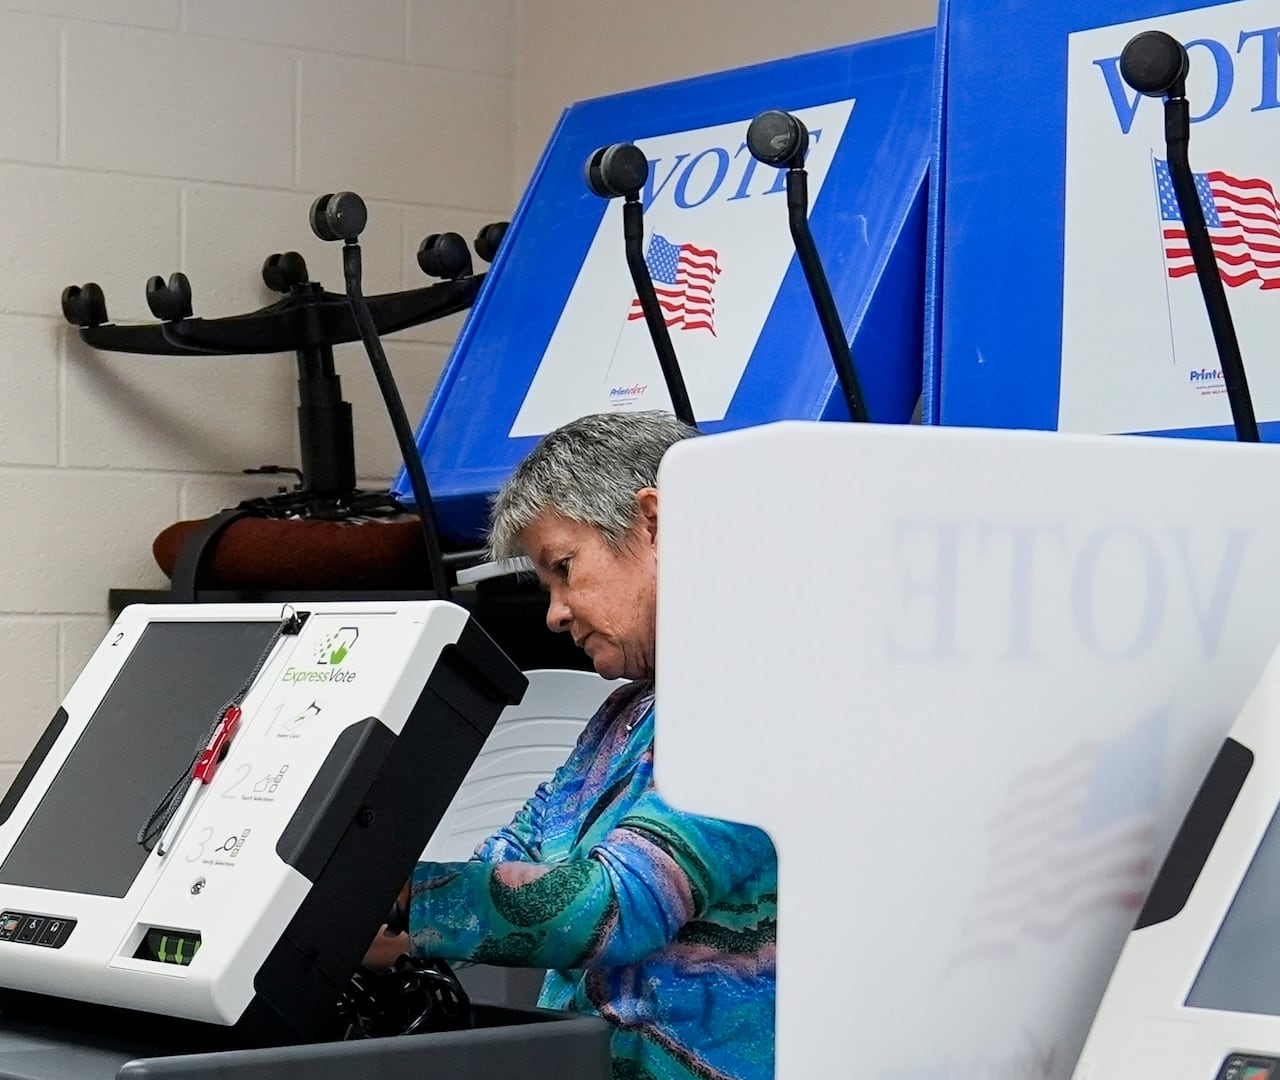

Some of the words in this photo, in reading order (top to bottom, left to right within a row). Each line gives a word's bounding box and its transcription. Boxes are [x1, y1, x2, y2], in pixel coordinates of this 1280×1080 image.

[111, 632, 124, 646] 2
[281, 667, 357, 687] ExpressVote
[221, 763, 252, 798] 2
[185, 826, 214, 863] 3
